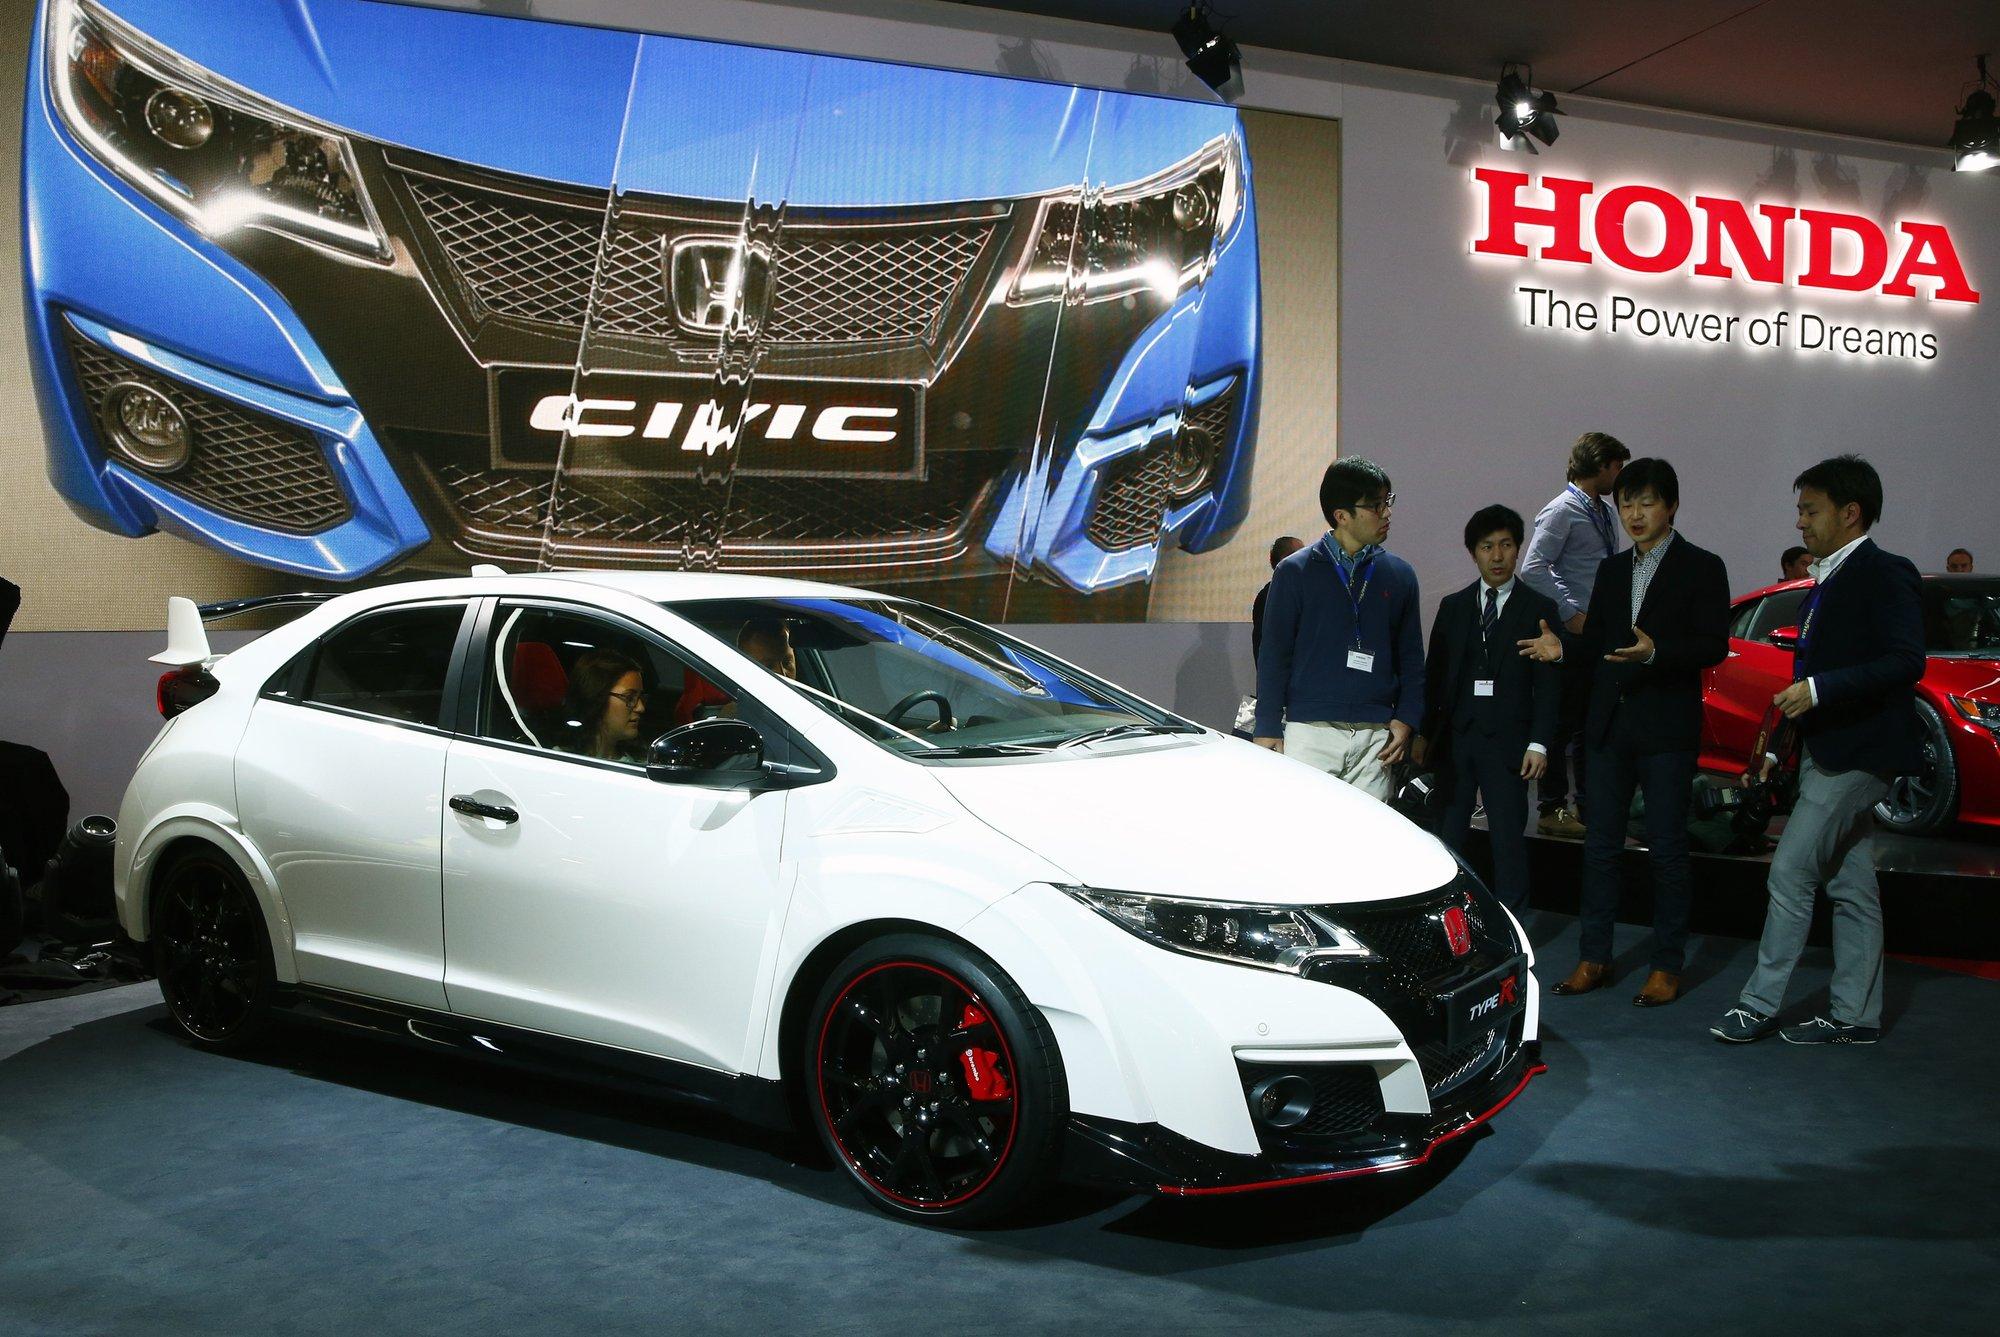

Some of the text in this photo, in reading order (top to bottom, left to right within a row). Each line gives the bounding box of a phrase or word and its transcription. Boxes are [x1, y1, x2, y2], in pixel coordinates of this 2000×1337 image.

[1471, 167, 1981, 304] HONDA
[1518, 286, 1938, 360] The Power of Dreams
[529, 387, 899, 456] CIVIC
[1469, 975, 1517, 1021] TYPE R
[968, 1056, 980, 1081] brembo
